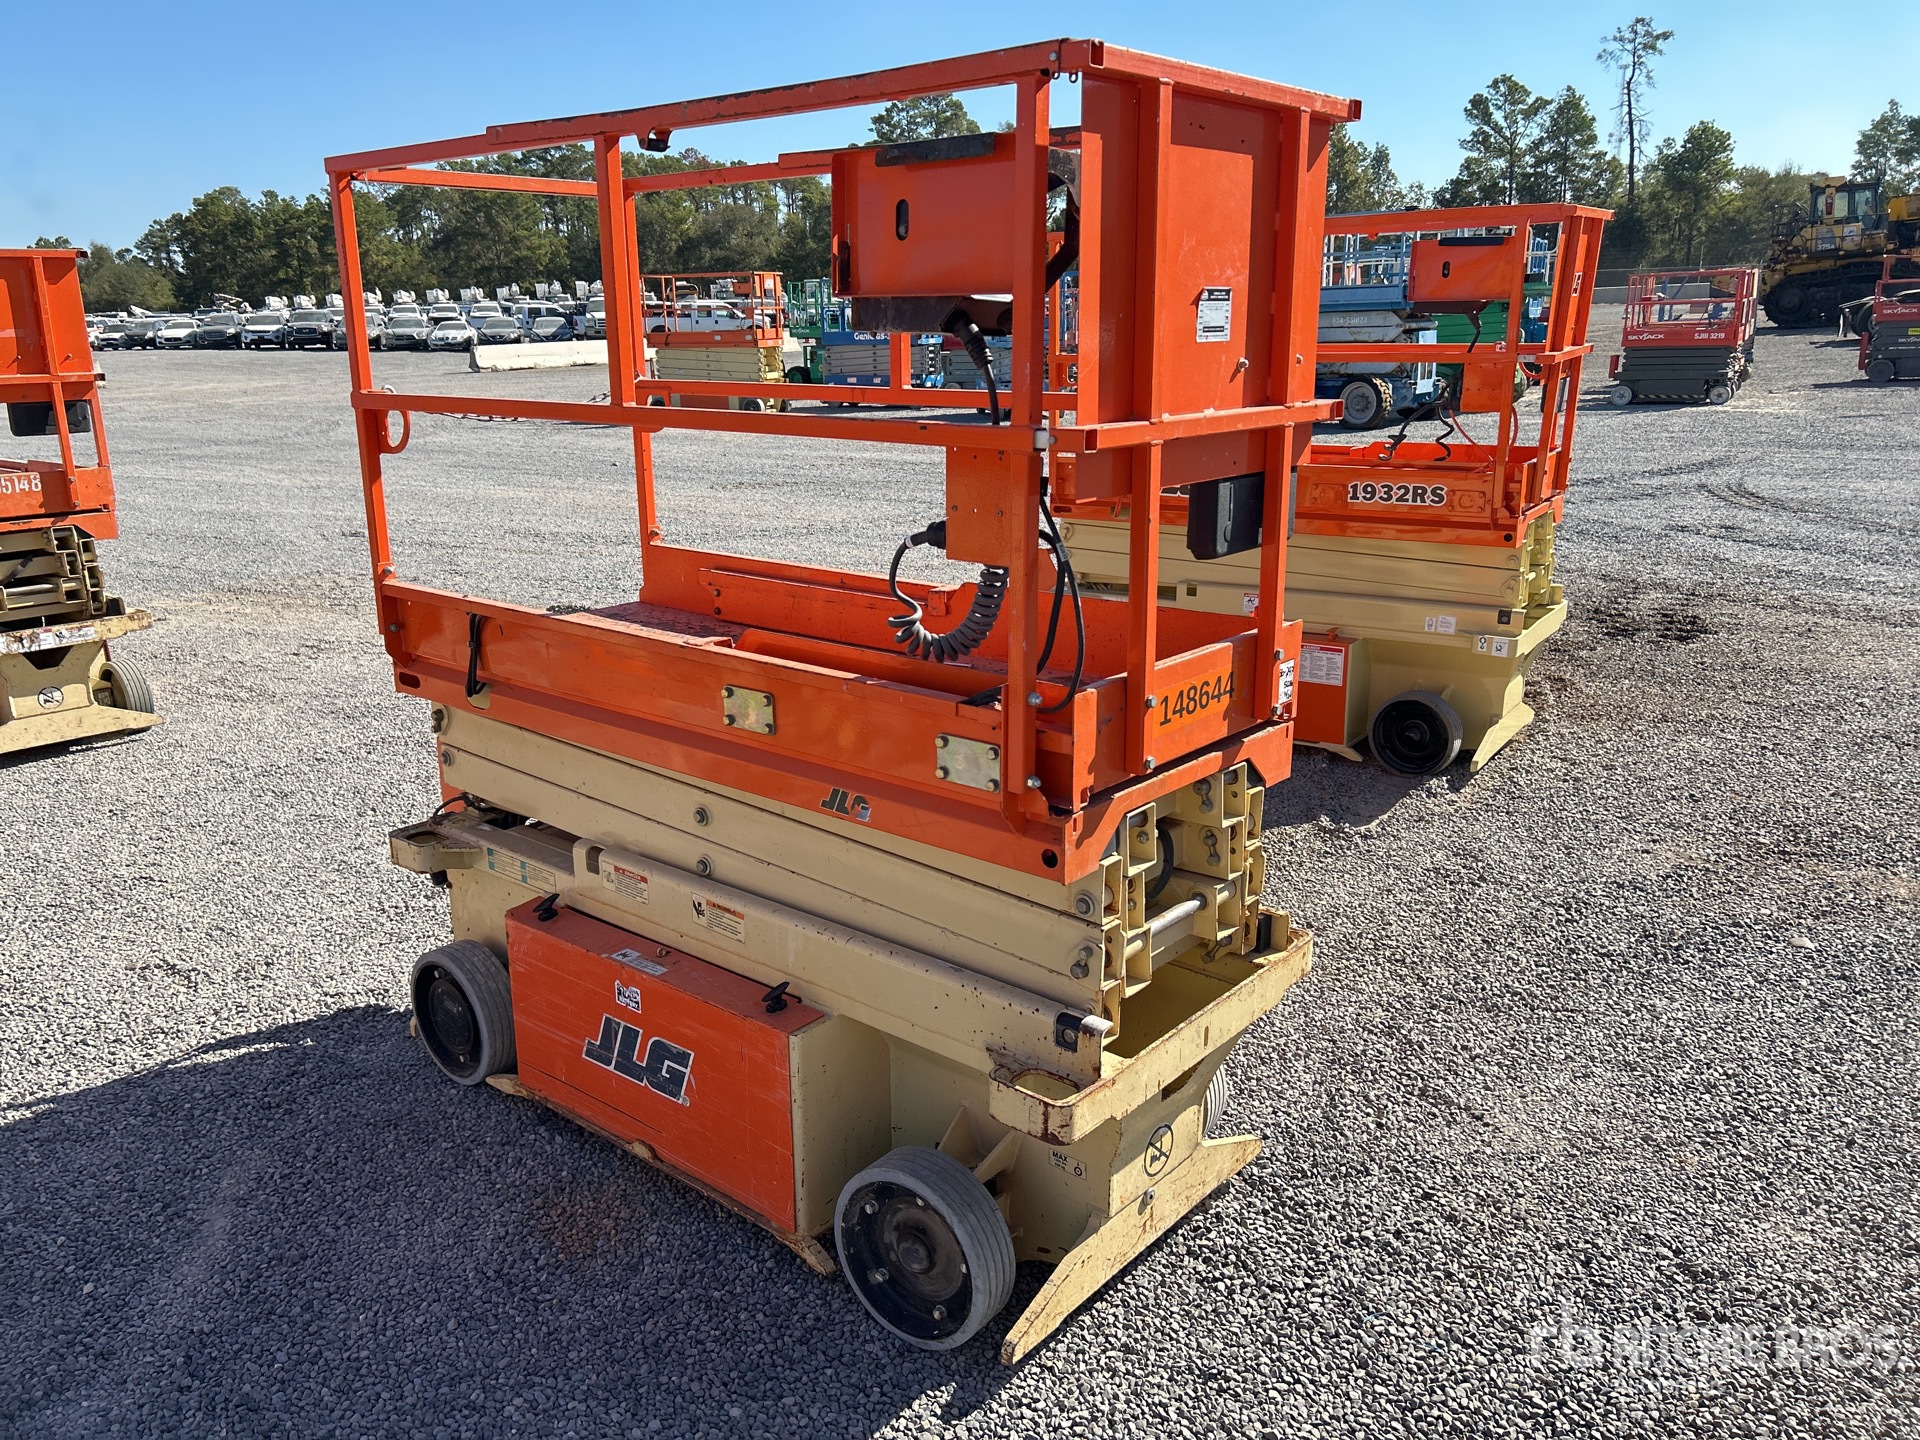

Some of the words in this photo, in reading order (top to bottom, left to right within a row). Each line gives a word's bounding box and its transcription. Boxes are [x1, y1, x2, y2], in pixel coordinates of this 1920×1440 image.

[1627, 332, 1665, 341] SKYJACK
[0, 474, 42, 495] 5148
[1348, 482, 1447, 506] 1932RS
[1159, 671, 1235, 727] 148644
[819, 786, 871, 822] JLG
[582, 1013, 695, 1104] JLG
[1053, 1151, 1068, 1162] MAX
